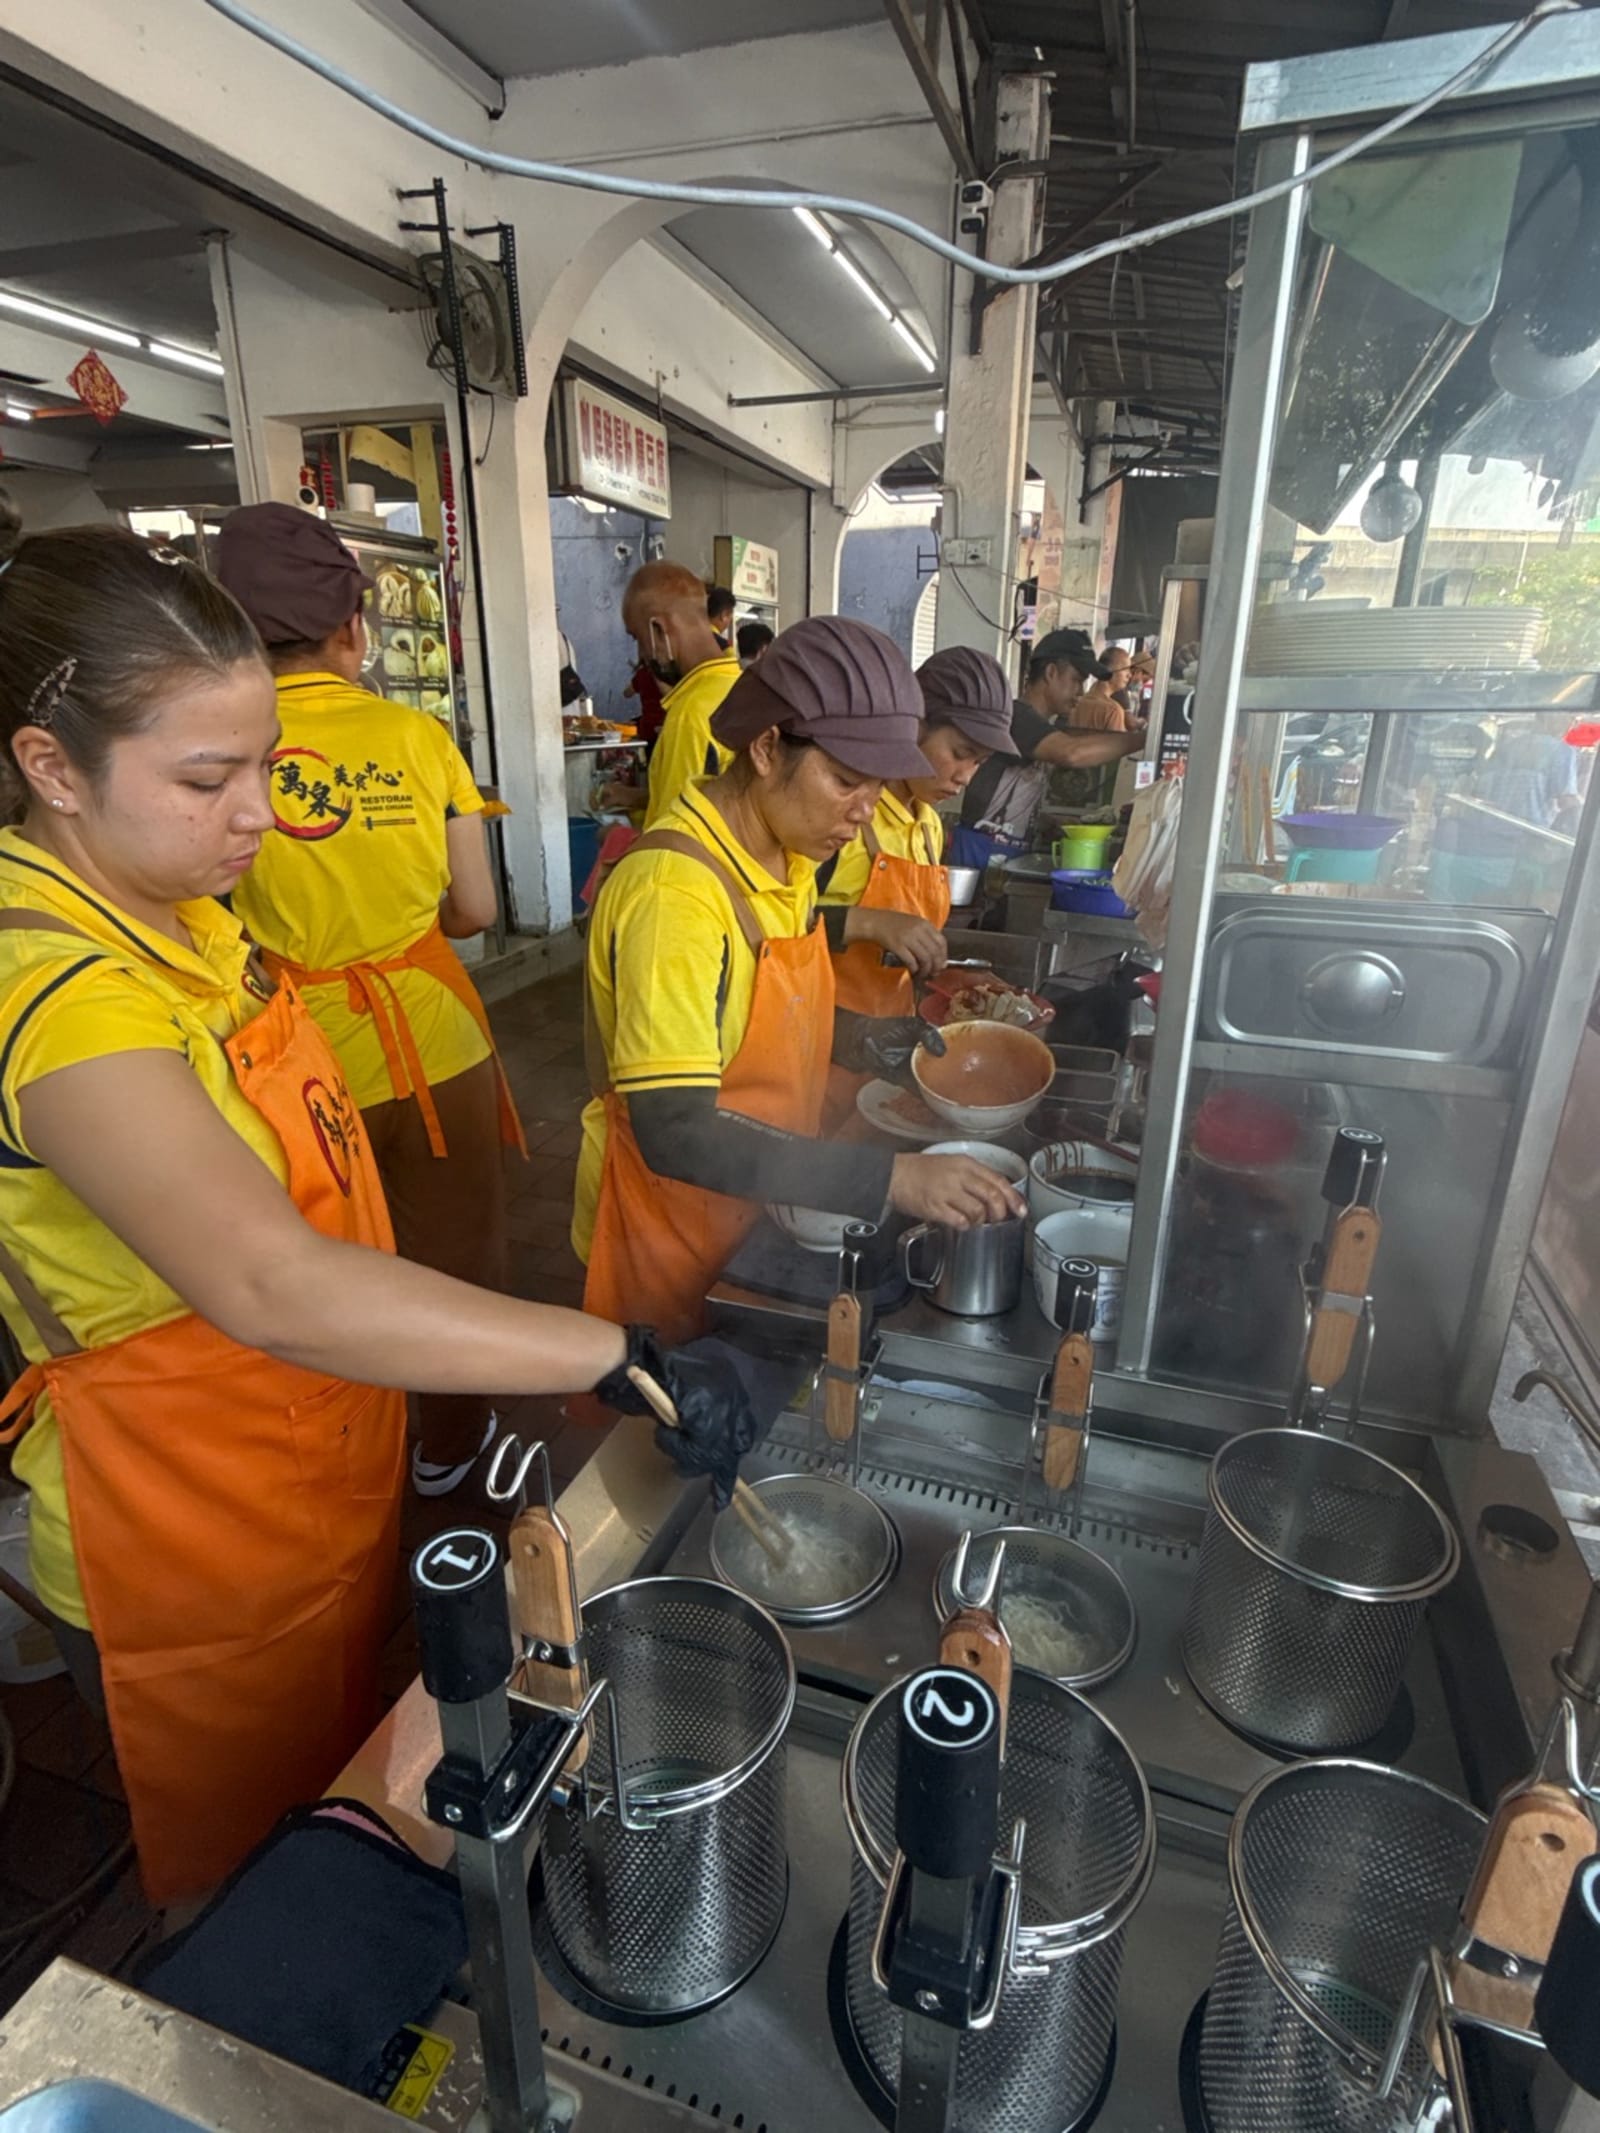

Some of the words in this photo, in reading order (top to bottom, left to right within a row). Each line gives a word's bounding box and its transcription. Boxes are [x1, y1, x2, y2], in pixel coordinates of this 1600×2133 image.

[334, 761, 404, 791] 美食中心
[360, 794, 413, 804] RESTORAN
[1068, 1262, 1090, 1273] 2
[431, 1544, 478, 1571] 1
[922, 1689, 975, 1727] 2
